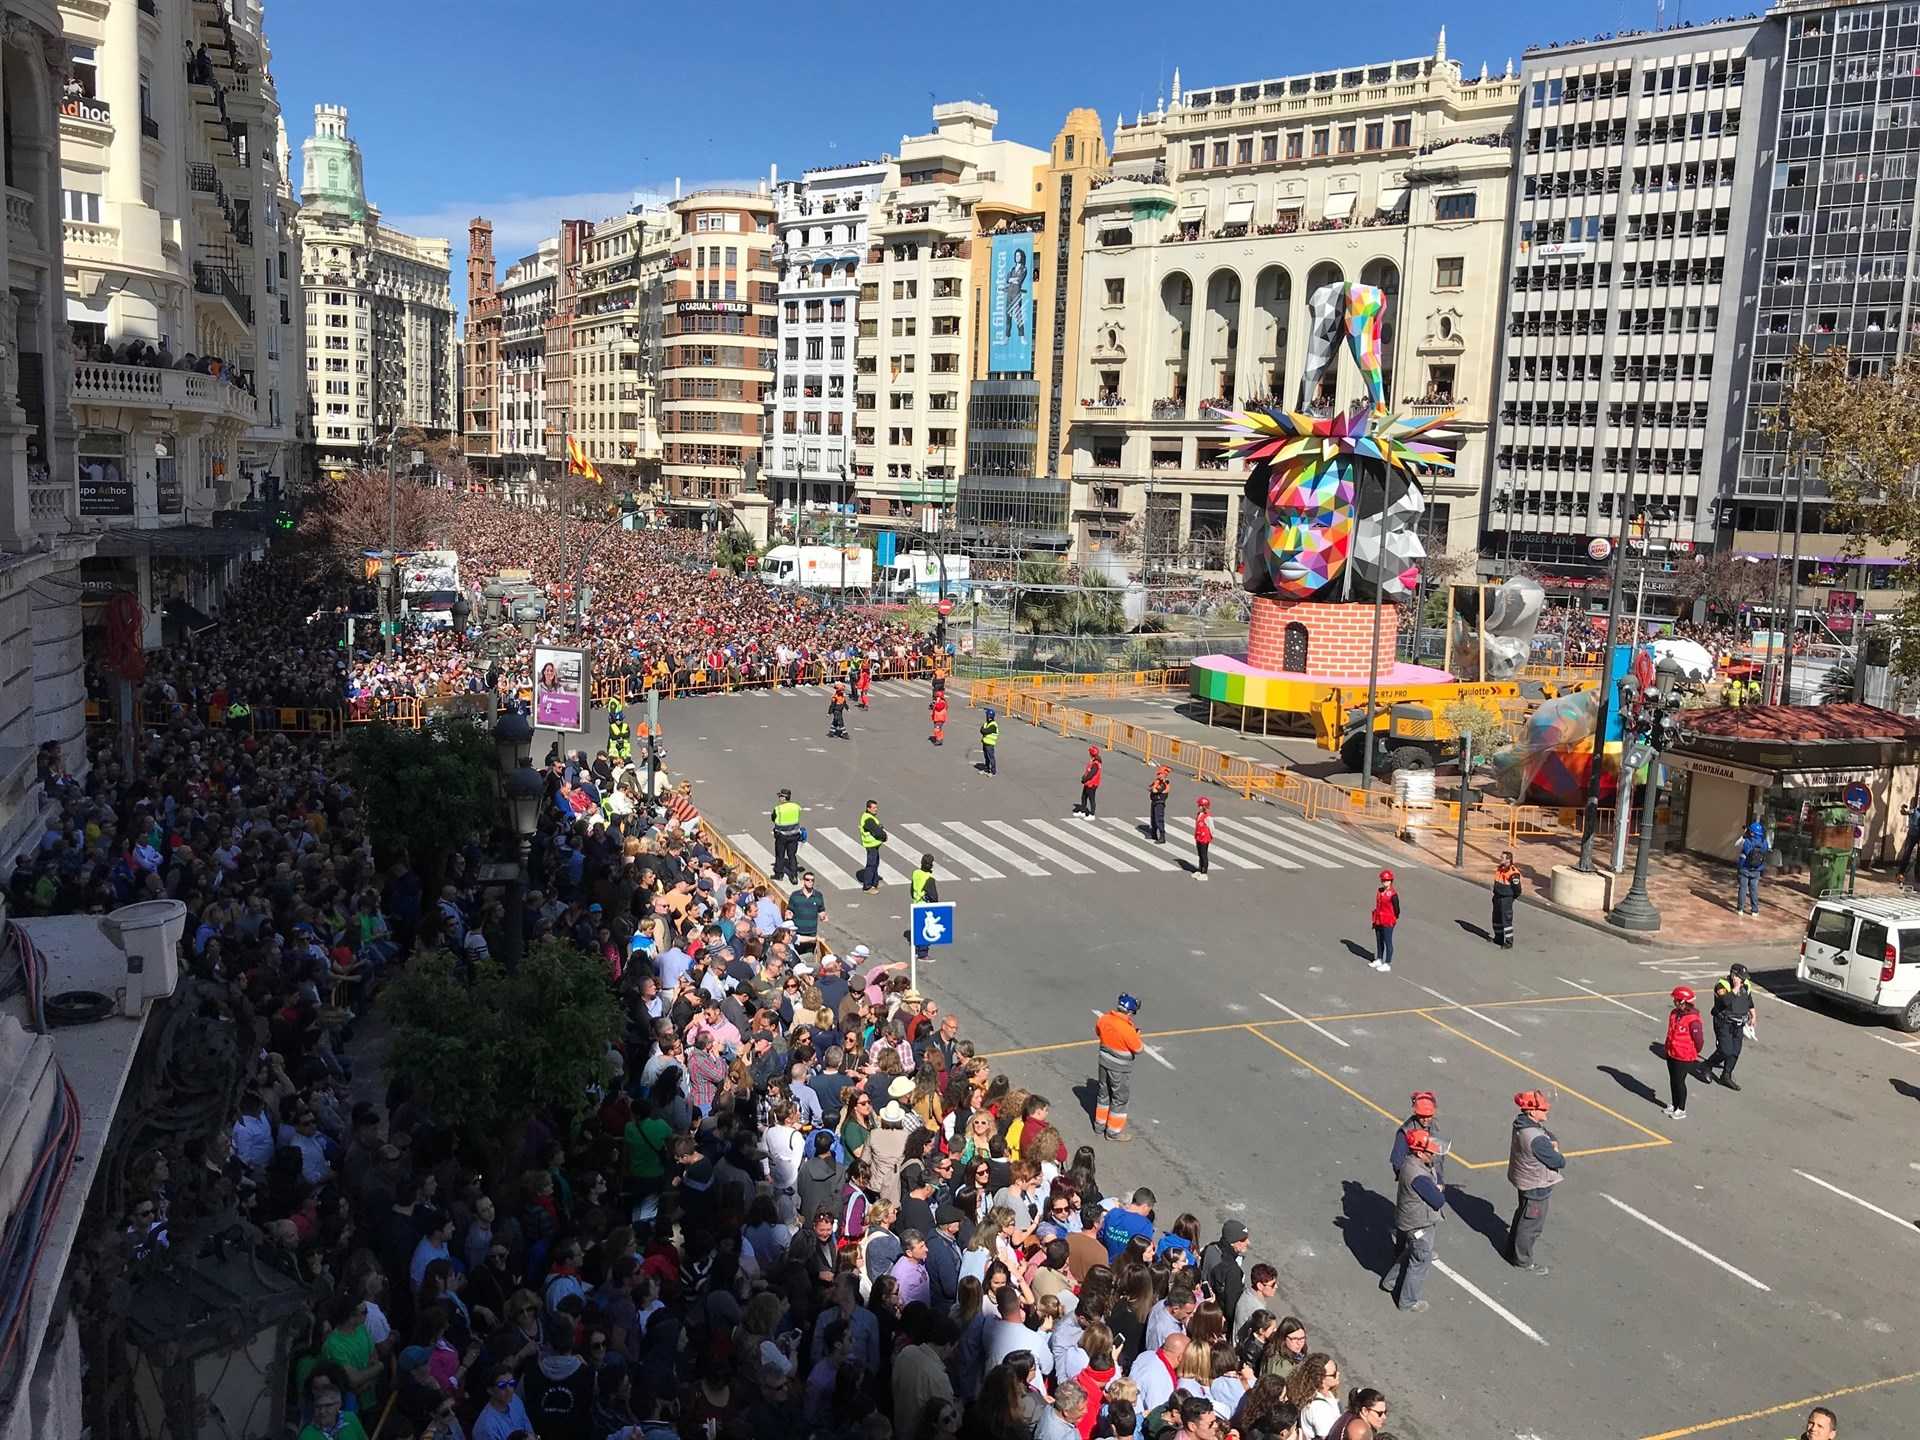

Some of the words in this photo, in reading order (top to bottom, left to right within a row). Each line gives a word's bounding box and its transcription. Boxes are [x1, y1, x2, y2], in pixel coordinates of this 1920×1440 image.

[992, 251, 1007, 328] filmoteca
[1551, 536, 1577, 545] KING
[1752, 606, 1786, 614] TACO
[1458, 687, 1490, 697] Haulotte
